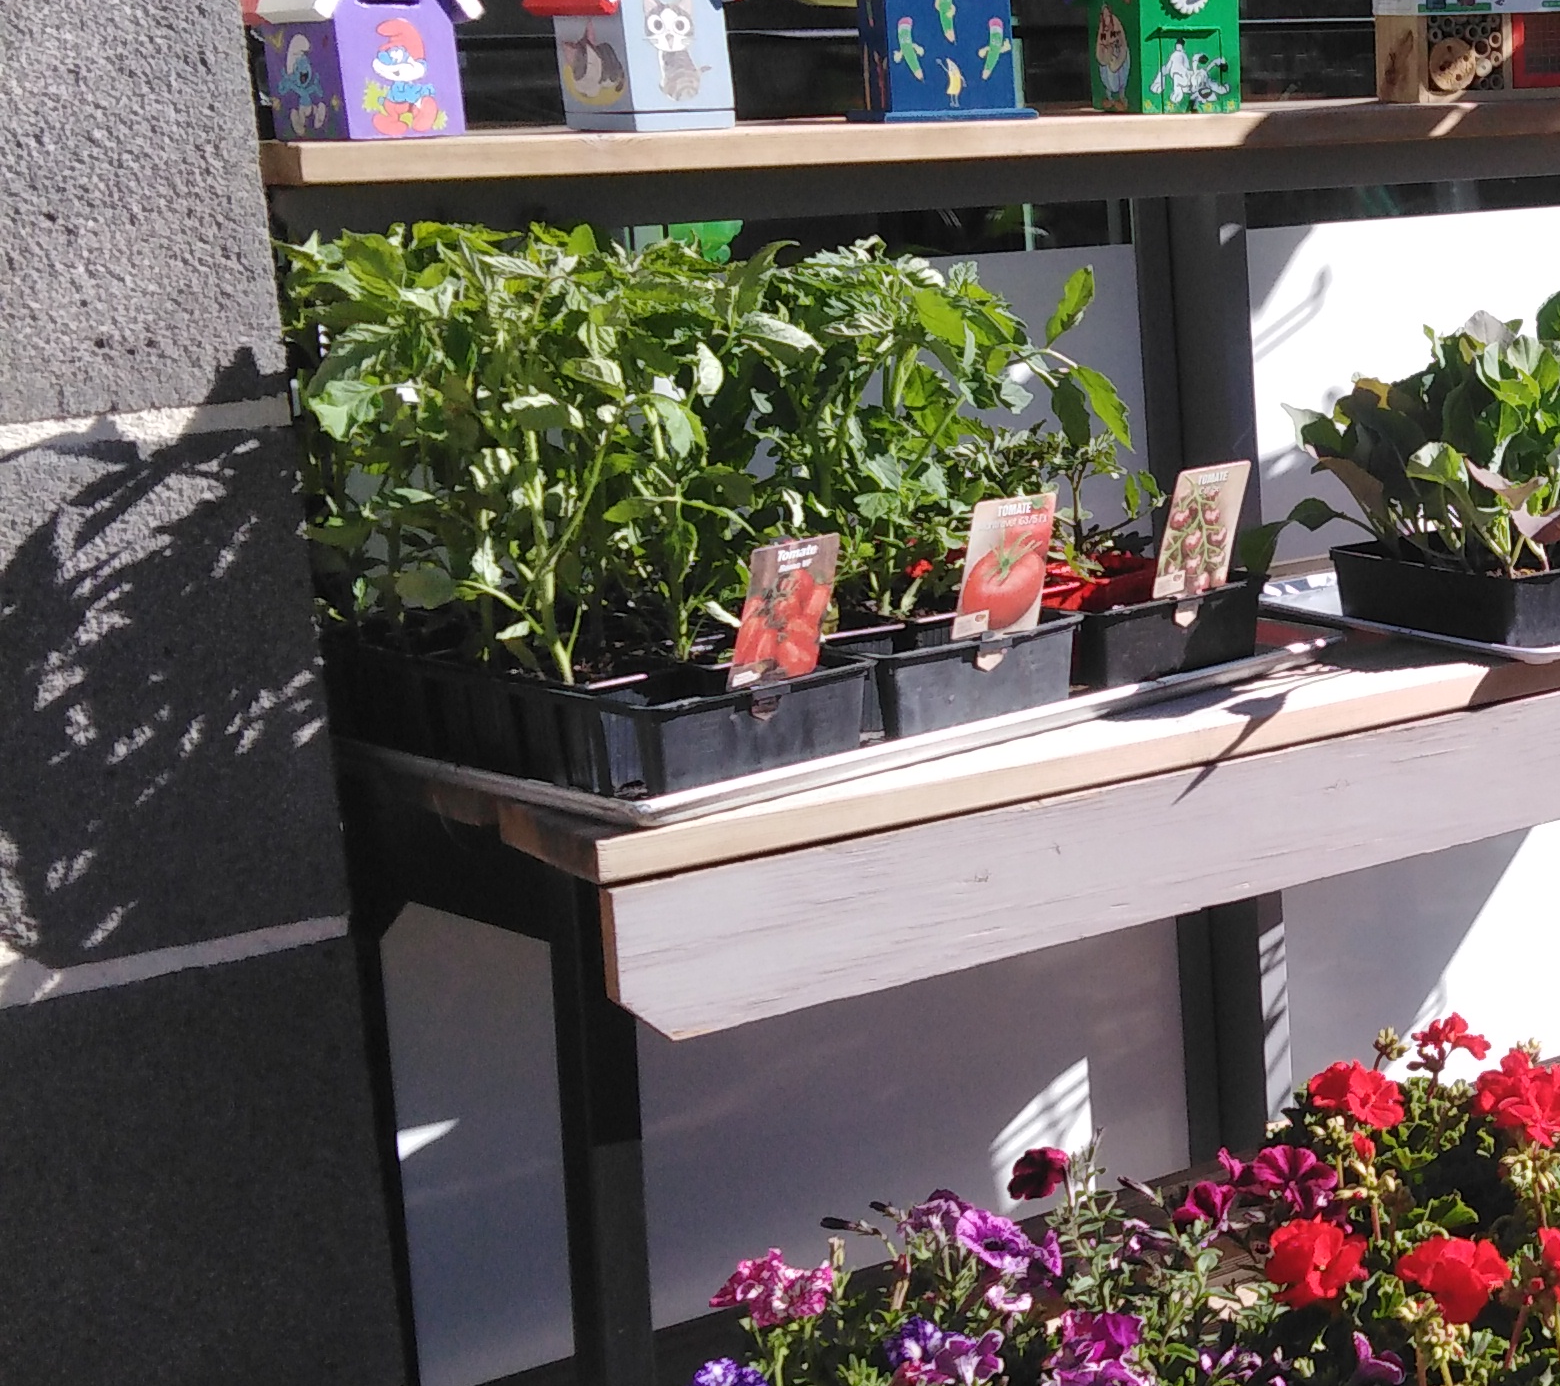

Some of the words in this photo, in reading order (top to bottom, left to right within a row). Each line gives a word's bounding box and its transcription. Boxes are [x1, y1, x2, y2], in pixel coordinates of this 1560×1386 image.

[1198, 471, 1229, 486] TOMATE
[997, 501, 1034, 517] TOMATE
[777, 544, 819, 562] Tomate
